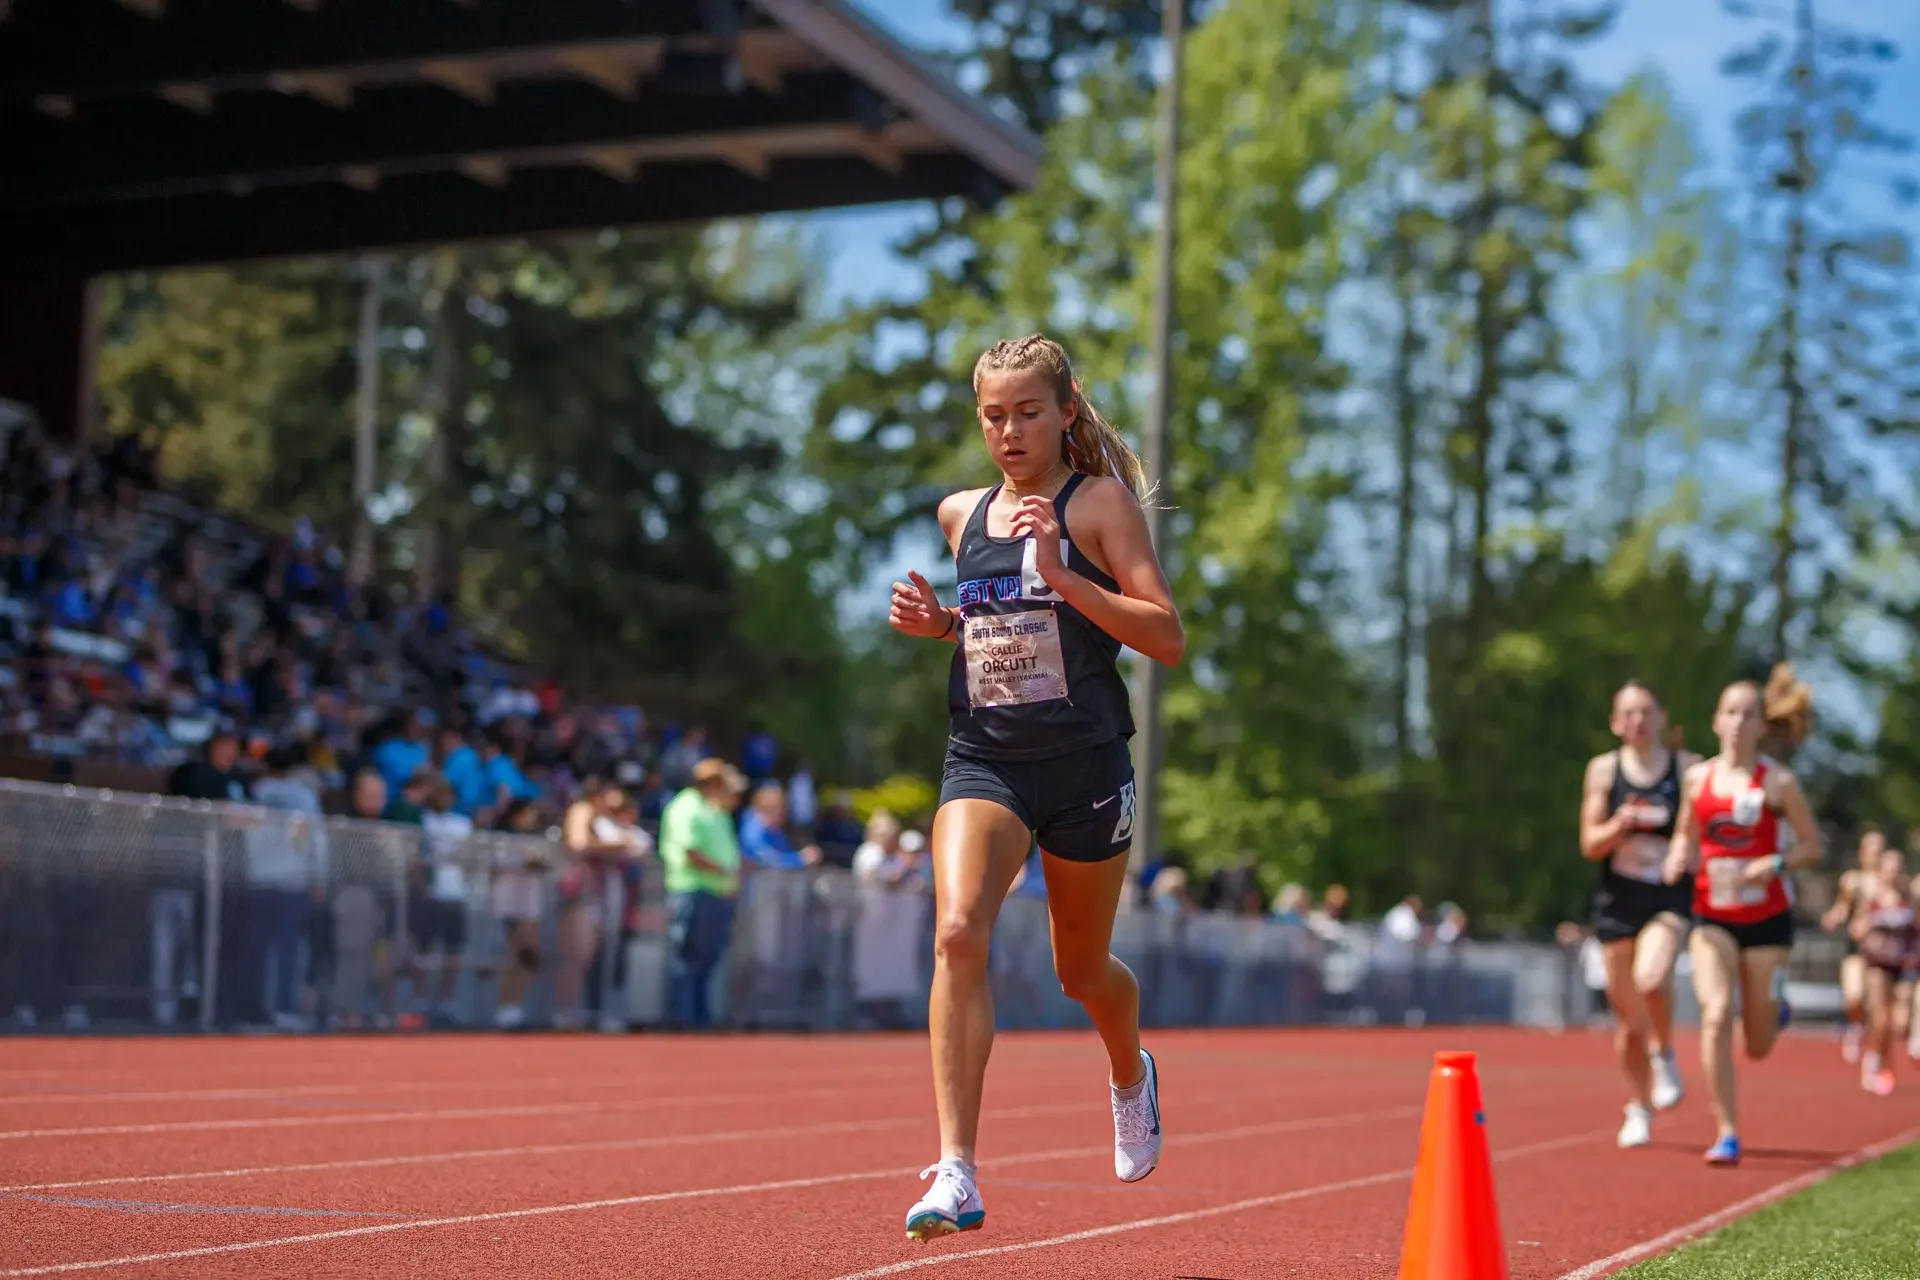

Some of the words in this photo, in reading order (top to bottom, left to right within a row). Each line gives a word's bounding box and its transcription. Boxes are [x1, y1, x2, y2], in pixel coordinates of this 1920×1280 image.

[972, 627, 990, 639] SOUTH
[1014, 621, 1048, 635] CLASSIC
[991, 645, 1023, 656] CALLIE
[982, 656, 1038, 673] ORCUTT
[994, 676, 1016, 684] VALLEY
